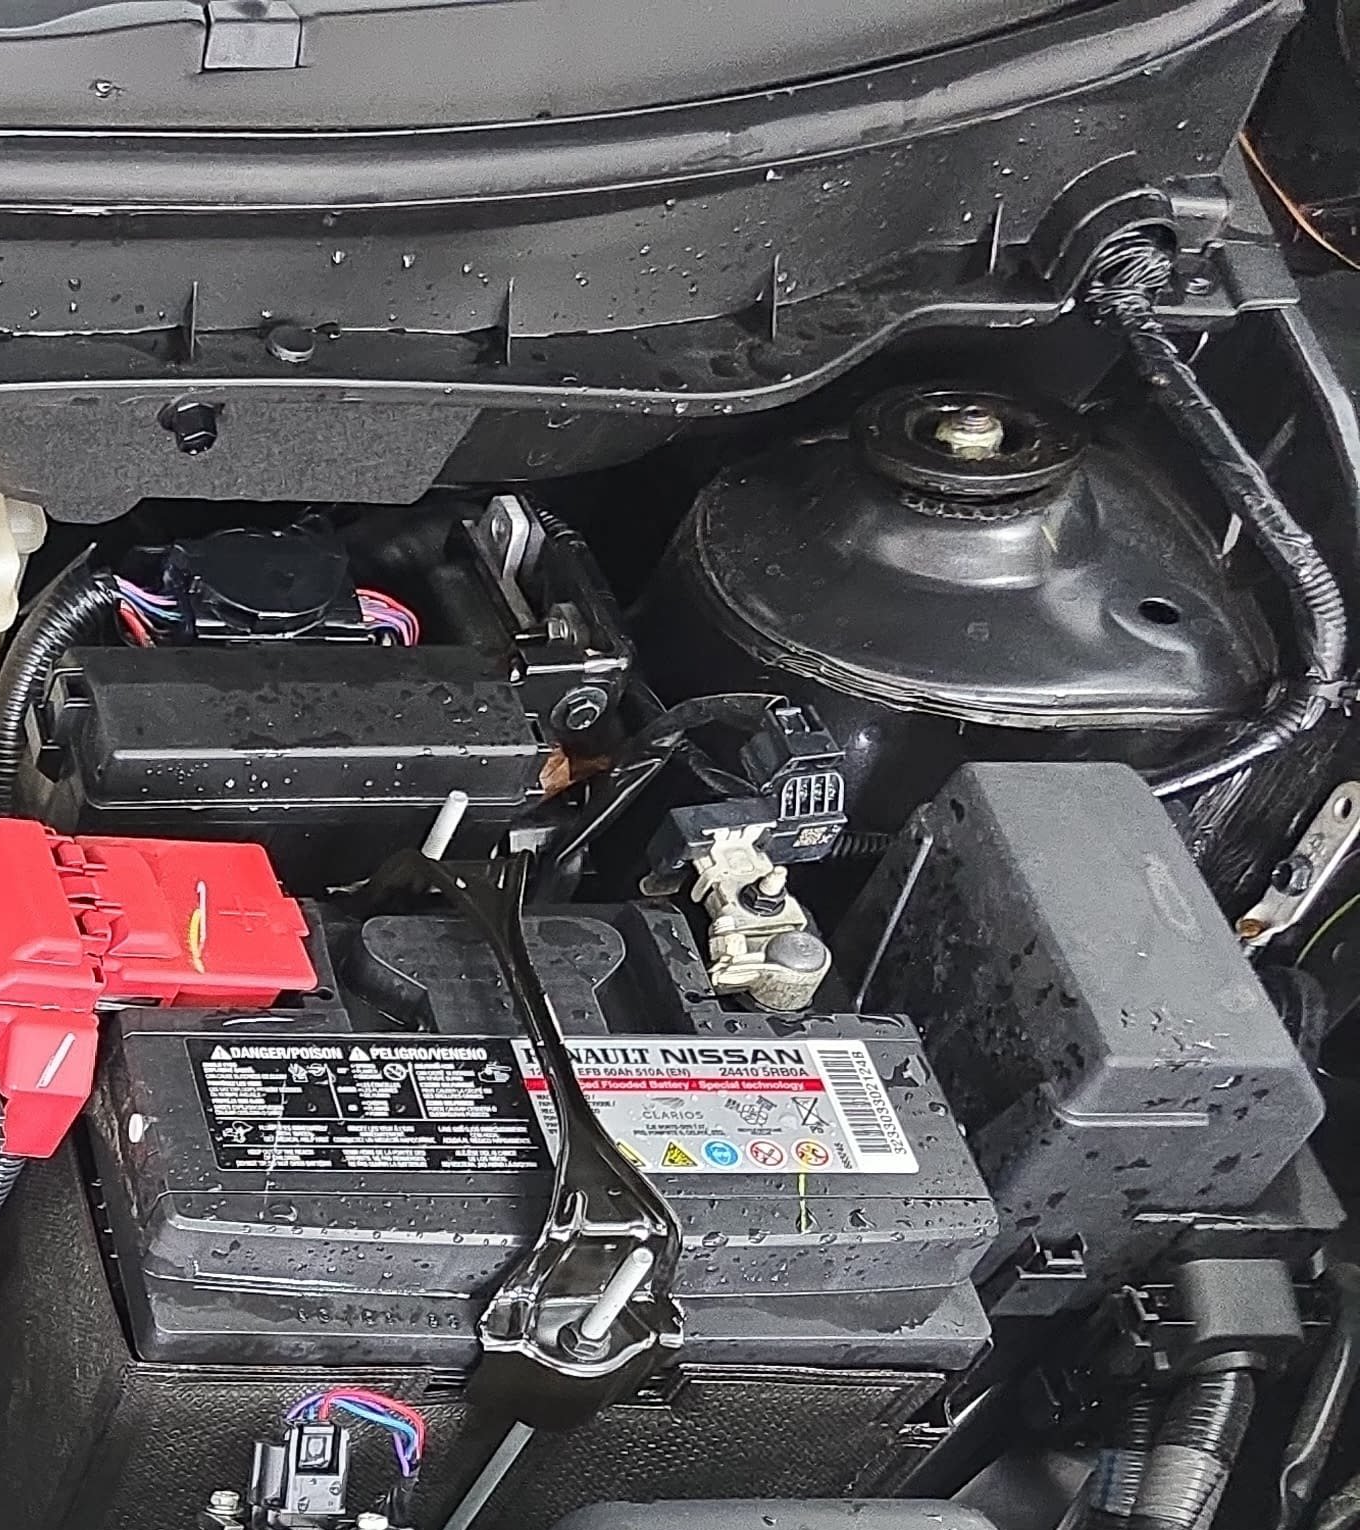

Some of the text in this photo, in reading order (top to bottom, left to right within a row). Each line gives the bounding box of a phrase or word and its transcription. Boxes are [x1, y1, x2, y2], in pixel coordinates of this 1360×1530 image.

[230, 1047, 343, 1060] DANGER/POISON
[370, 1047, 487, 1060] PELIGRO/VENENO
[520, 1048, 805, 1065] RNAULT NISSAN
[578, 1068, 601, 1076] EFB
[635, 1068, 664, 1076] 510A
[718, 1067, 759, 1076] 24410
[601, 1080, 647, 1089] Flooded
[650, 1080, 689, 1091] Battery
[699, 1080, 740, 1091] Special
[746, 1080, 805, 1091] technology
[642, 1111, 704, 1120] CLARIOS
